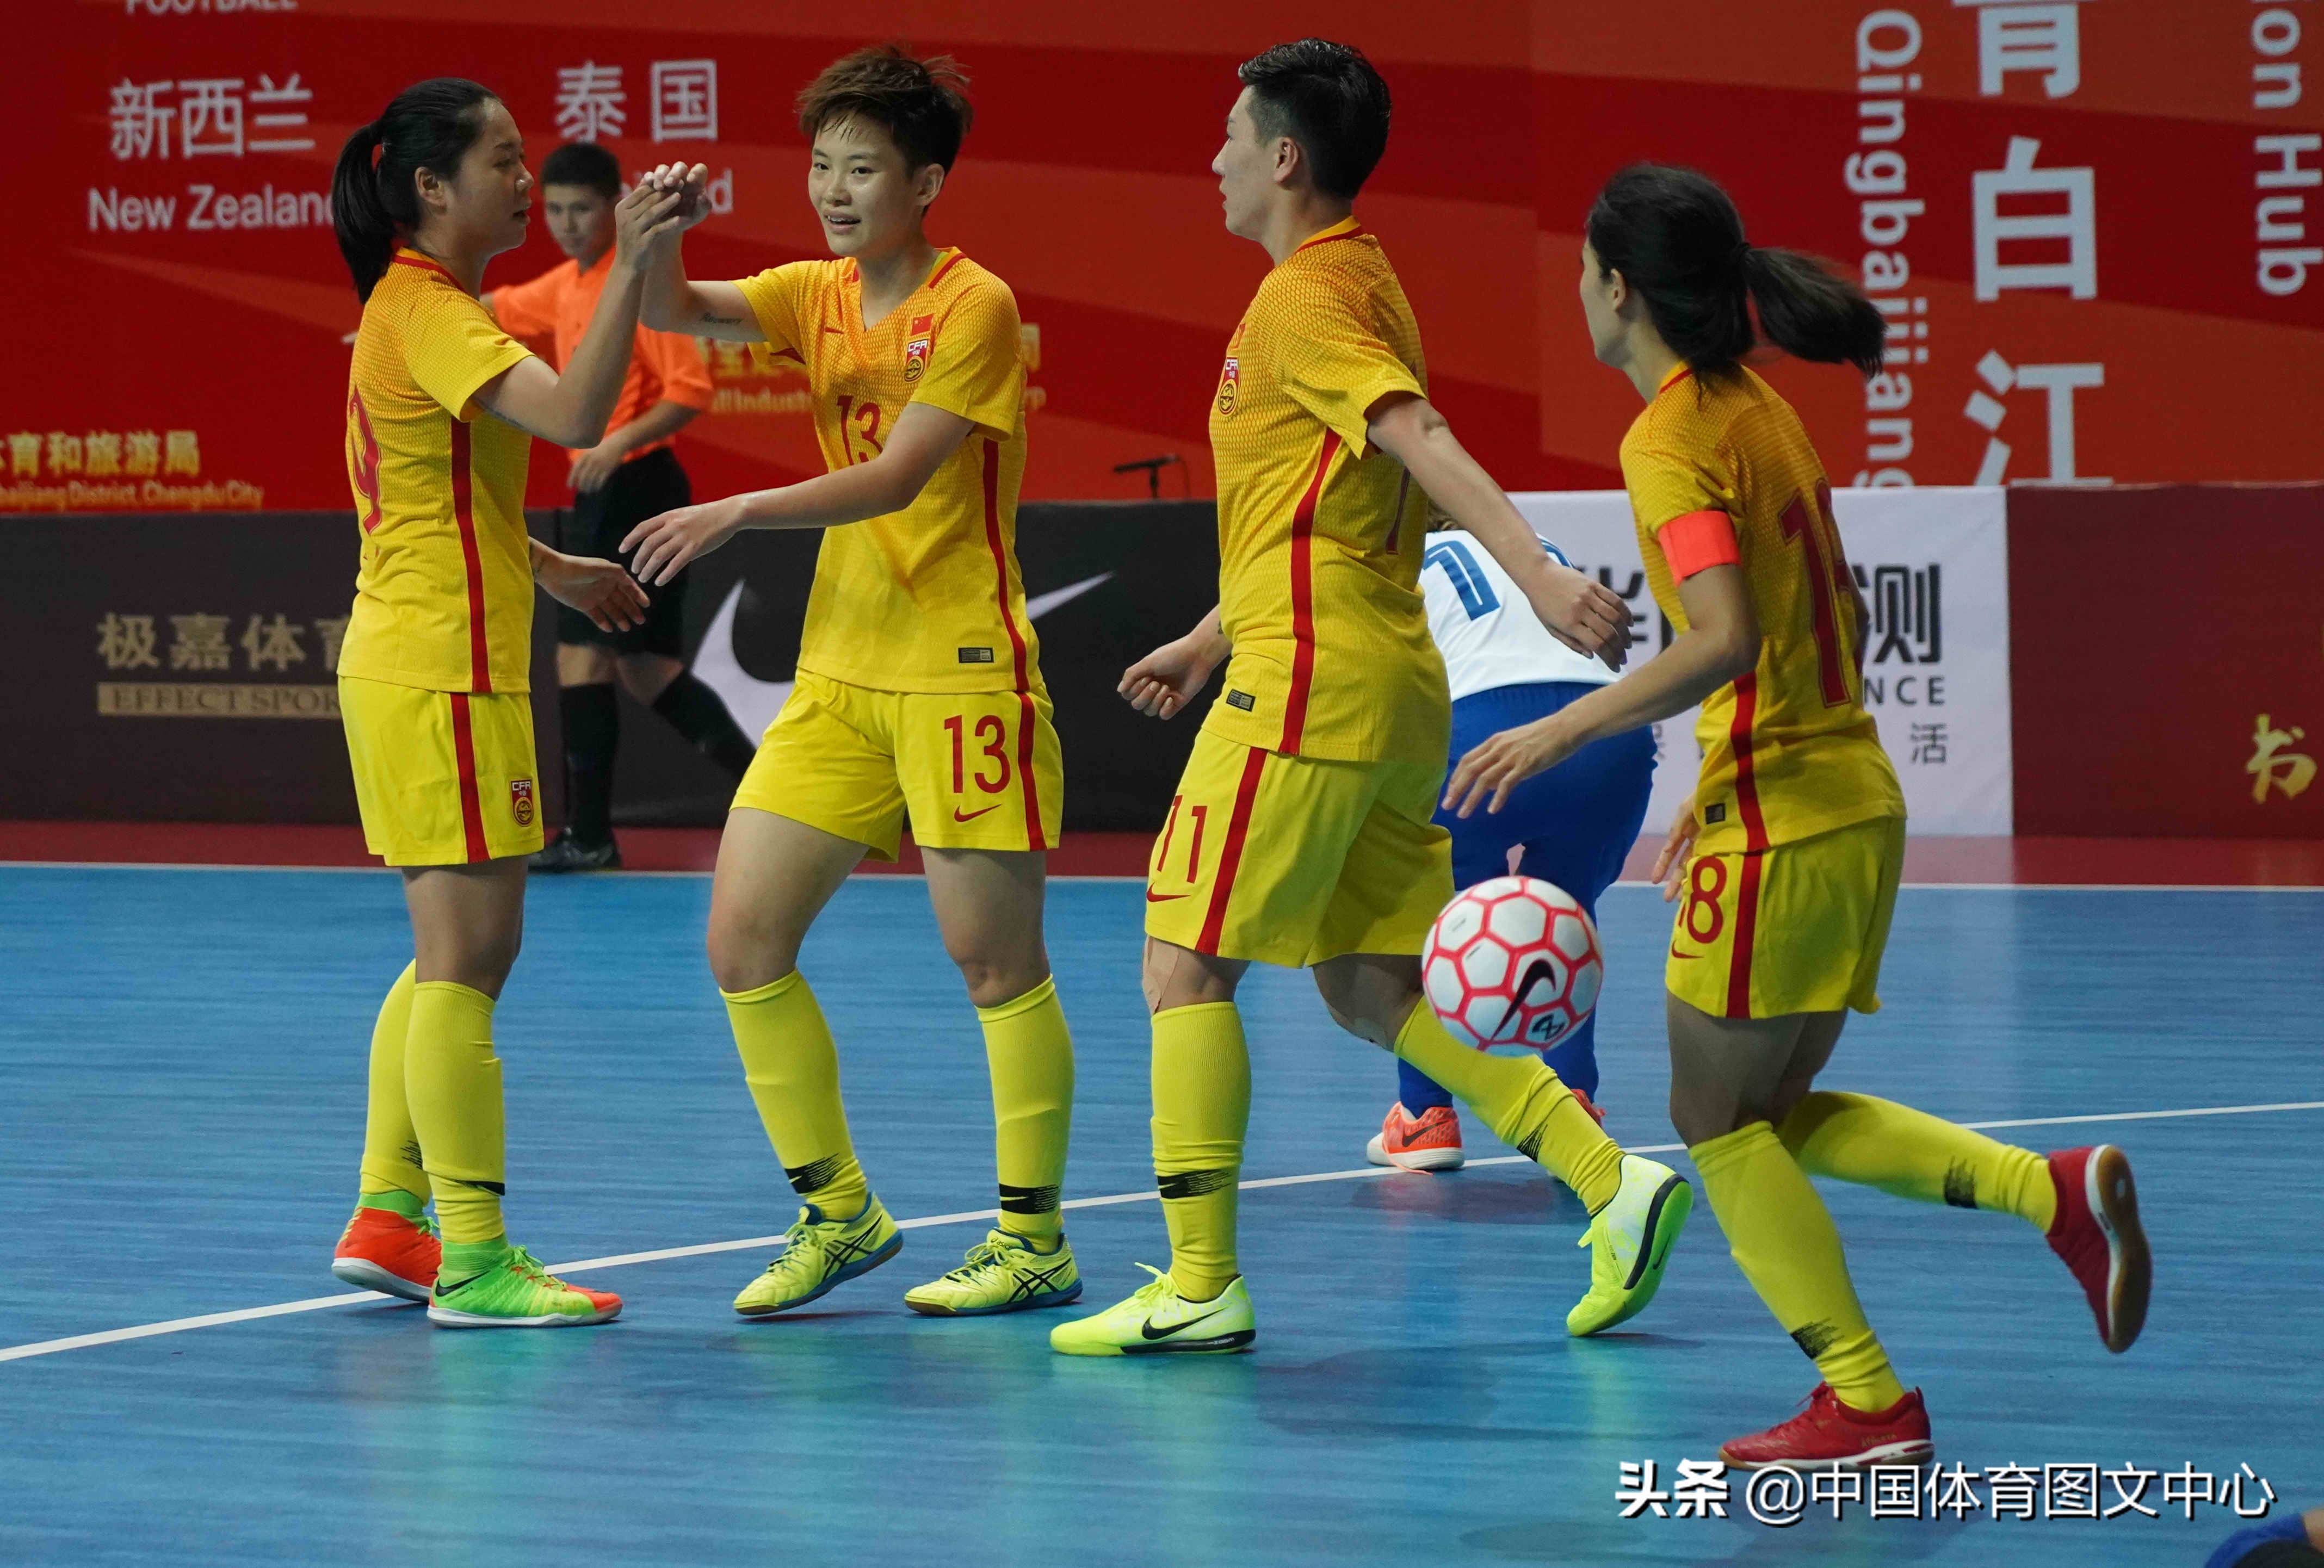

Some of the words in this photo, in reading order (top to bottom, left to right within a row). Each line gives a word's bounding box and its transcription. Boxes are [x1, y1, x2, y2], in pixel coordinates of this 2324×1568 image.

[2251, 0, 2302, 109] on
[110, 71, 316, 159] 新西兰
[555, 59, 718, 142] 泰国
[88, 187, 176, 231] New
[187, 183, 334, 230] Zealan
[2254, 133, 2324, 295] Hub
[908, 340, 928, 352] CFA
[0, 429, 200, 477] 育和旅游局
[837, 395, 883, 466] 13
[944, 715, 1011, 794] 13
[1157, 795, 1208, 884] 11
